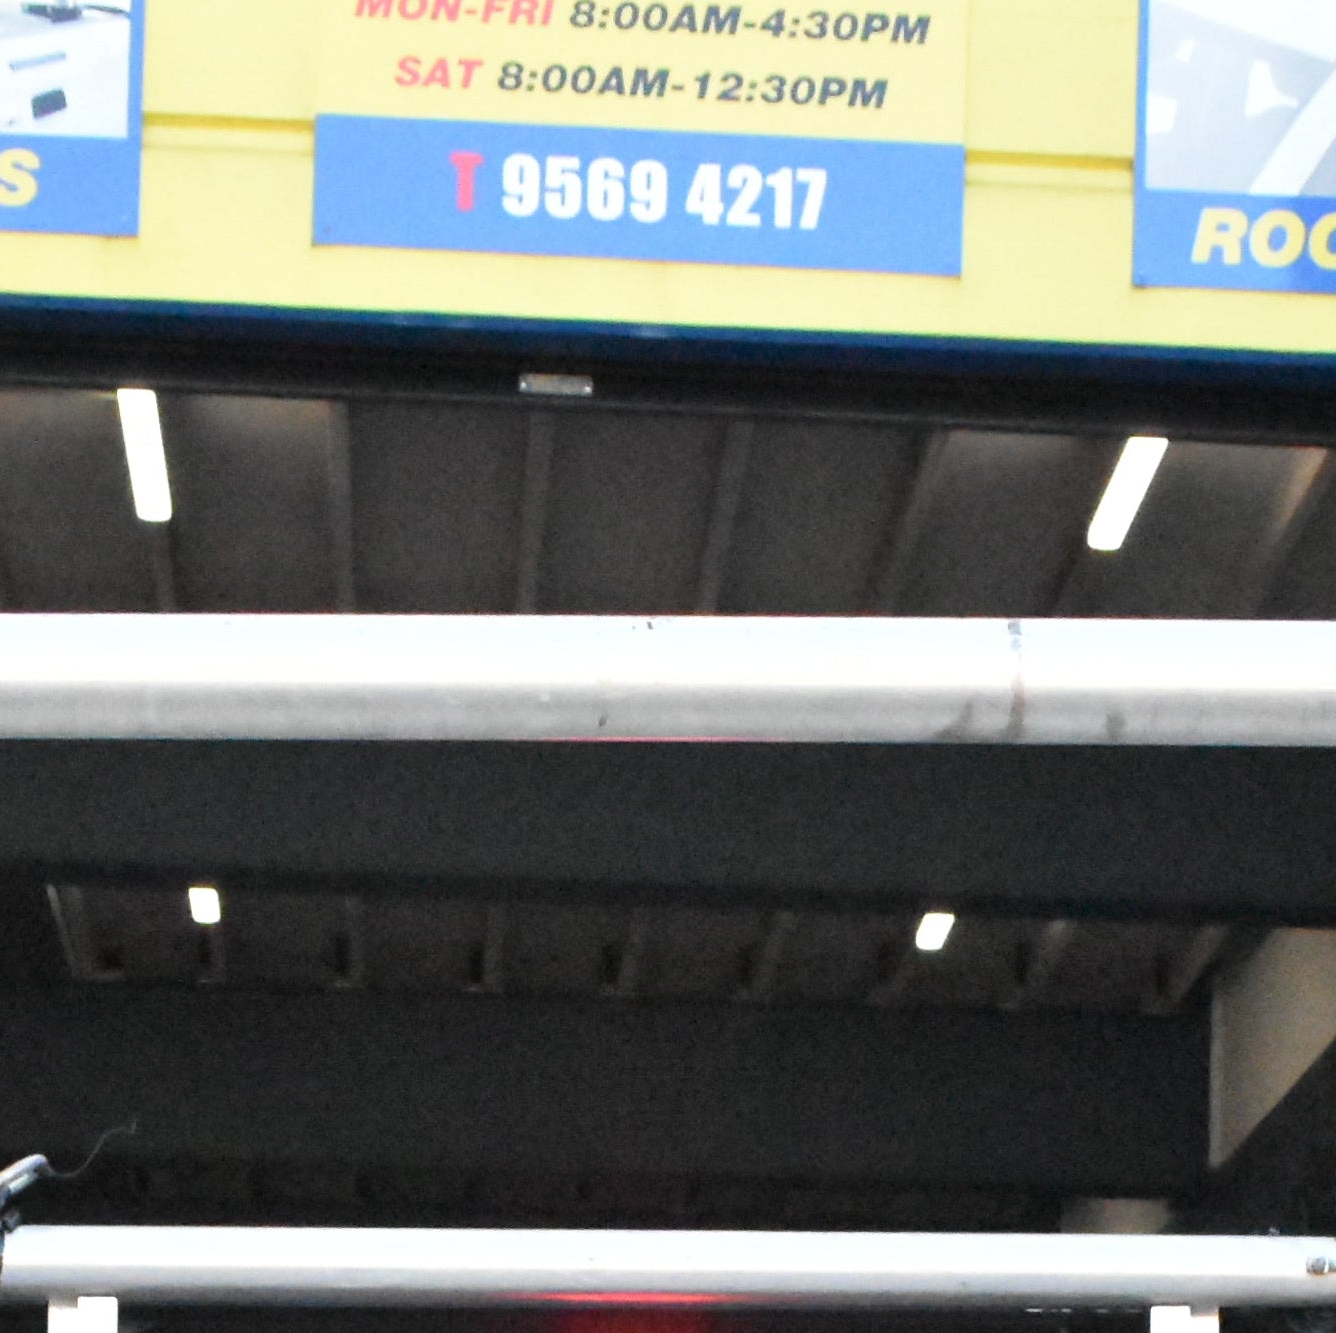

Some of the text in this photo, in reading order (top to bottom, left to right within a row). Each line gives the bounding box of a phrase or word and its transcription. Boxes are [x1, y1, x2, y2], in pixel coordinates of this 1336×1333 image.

[354, 0, 931, 45] MON-FRI 8:00AM-4:30PM
[394, 55, 889, 109] SAT 8:00AM-12:30PM
[450, 151, 828, 231] T 9569 4217
